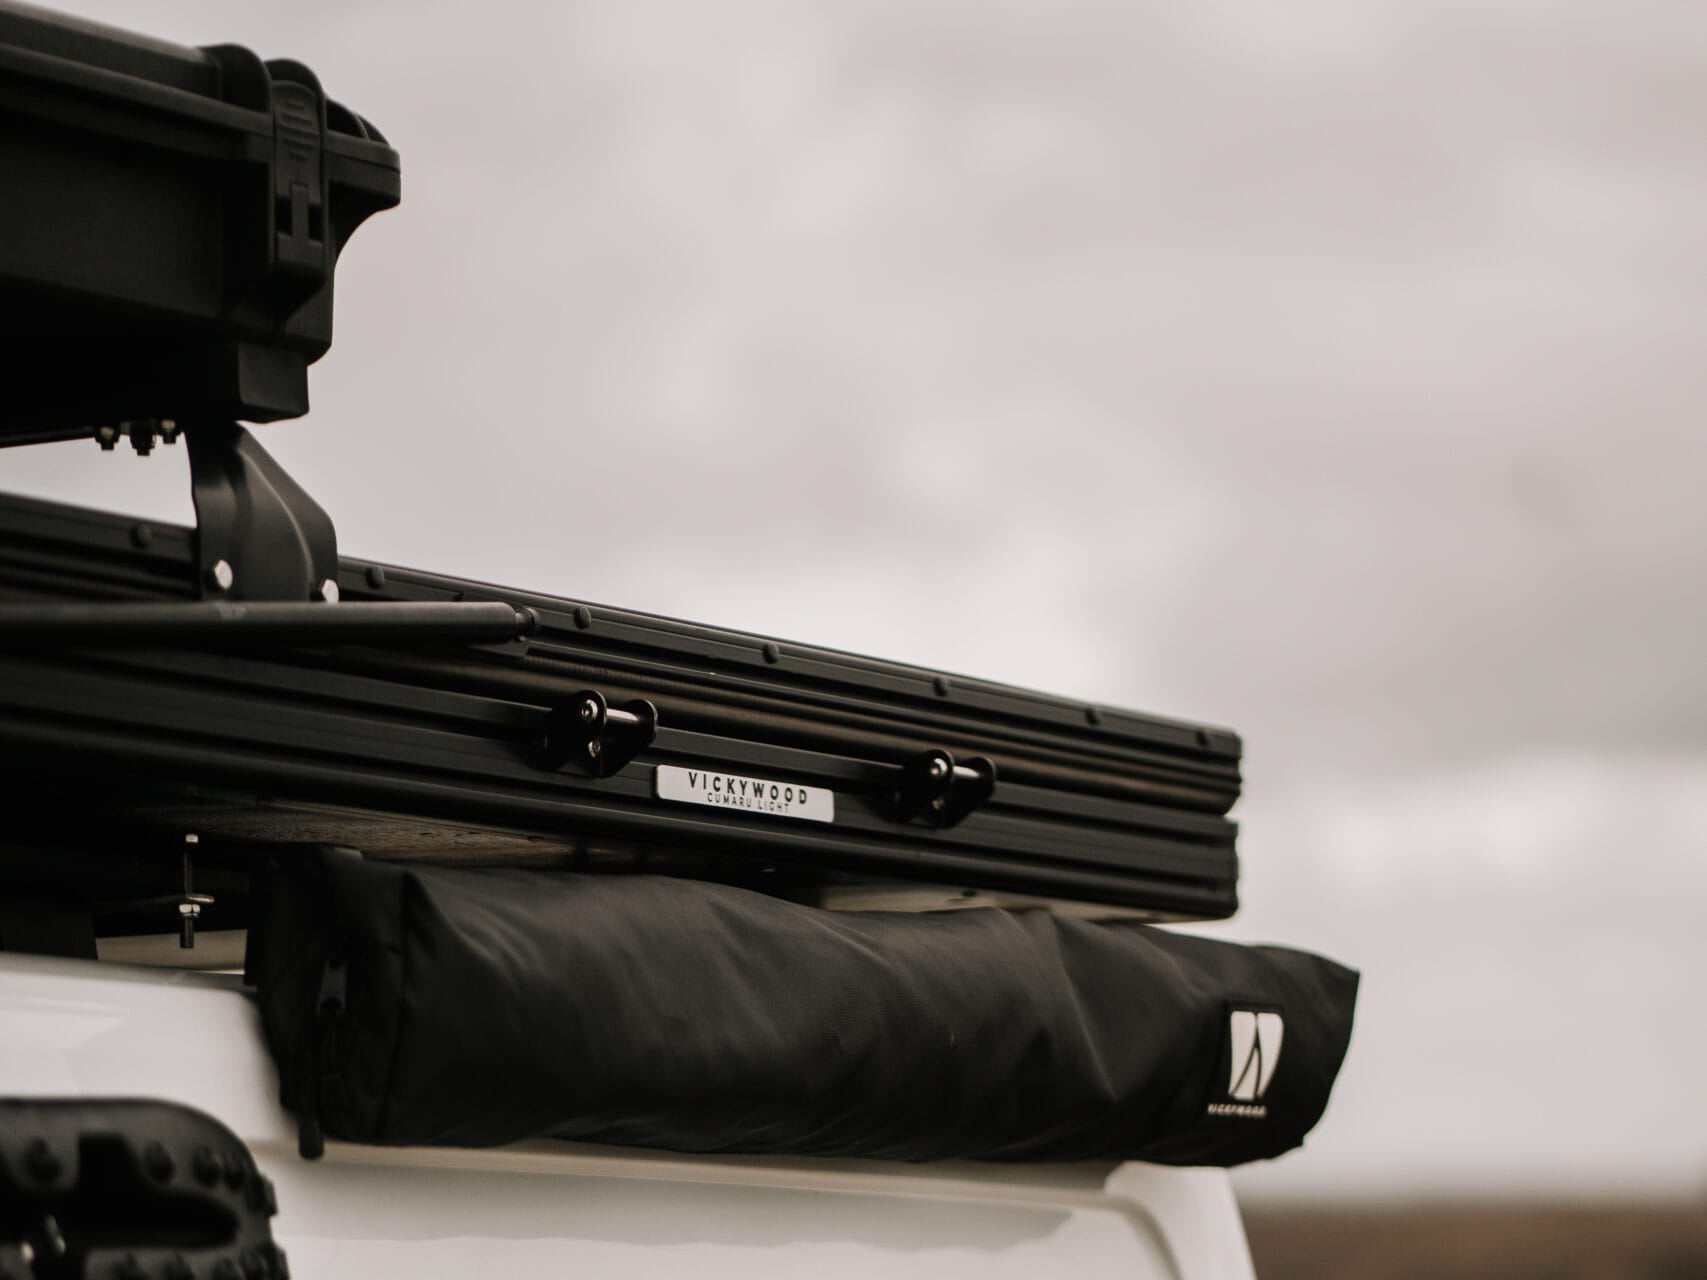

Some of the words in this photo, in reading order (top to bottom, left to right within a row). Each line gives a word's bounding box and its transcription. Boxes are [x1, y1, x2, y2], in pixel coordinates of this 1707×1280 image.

[688, 771, 807, 804] VICKYWOOD
[707, 792, 752, 808] CUMARU
[757, 800, 790, 813] LIGHT
